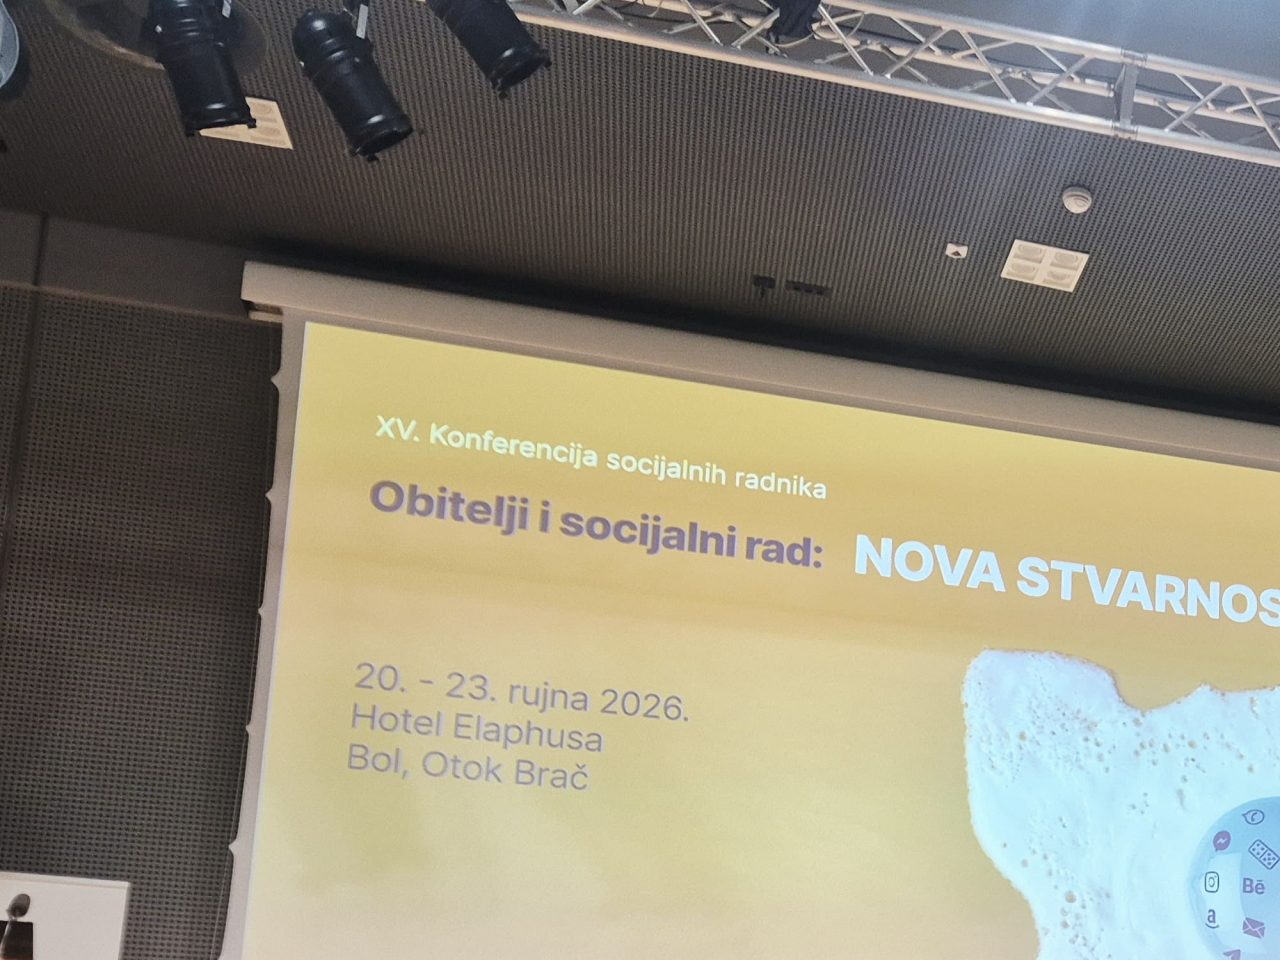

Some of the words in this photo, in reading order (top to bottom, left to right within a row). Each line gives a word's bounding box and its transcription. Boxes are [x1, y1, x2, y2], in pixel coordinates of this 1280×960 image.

[376, 415, 420, 442] XV.
[429, 422, 598, 469] Konferencija
[606, 450, 726, 486] socijalnih
[735, 468, 828, 500] radnika
[369, 479, 529, 536] Obitelji
[539, 500, 551, 533] i
[559, 510, 736, 558] socijalni
[745, 534, 824, 569] rad:
[855, 533, 1005, 593] NOVA
[354, 662, 406, 693] 20.
[445, 672, 496, 702] 23.
[508, 680, 589, 714] rujna
[600, 688, 690, 723] 2026.
[350, 702, 442, 738] Hotel
[454, 712, 604, 753] Elaphusa
[347, 743, 408, 779] Bol,
[421, 749, 503, 784] Otok
[515, 759, 589, 791] Brač
